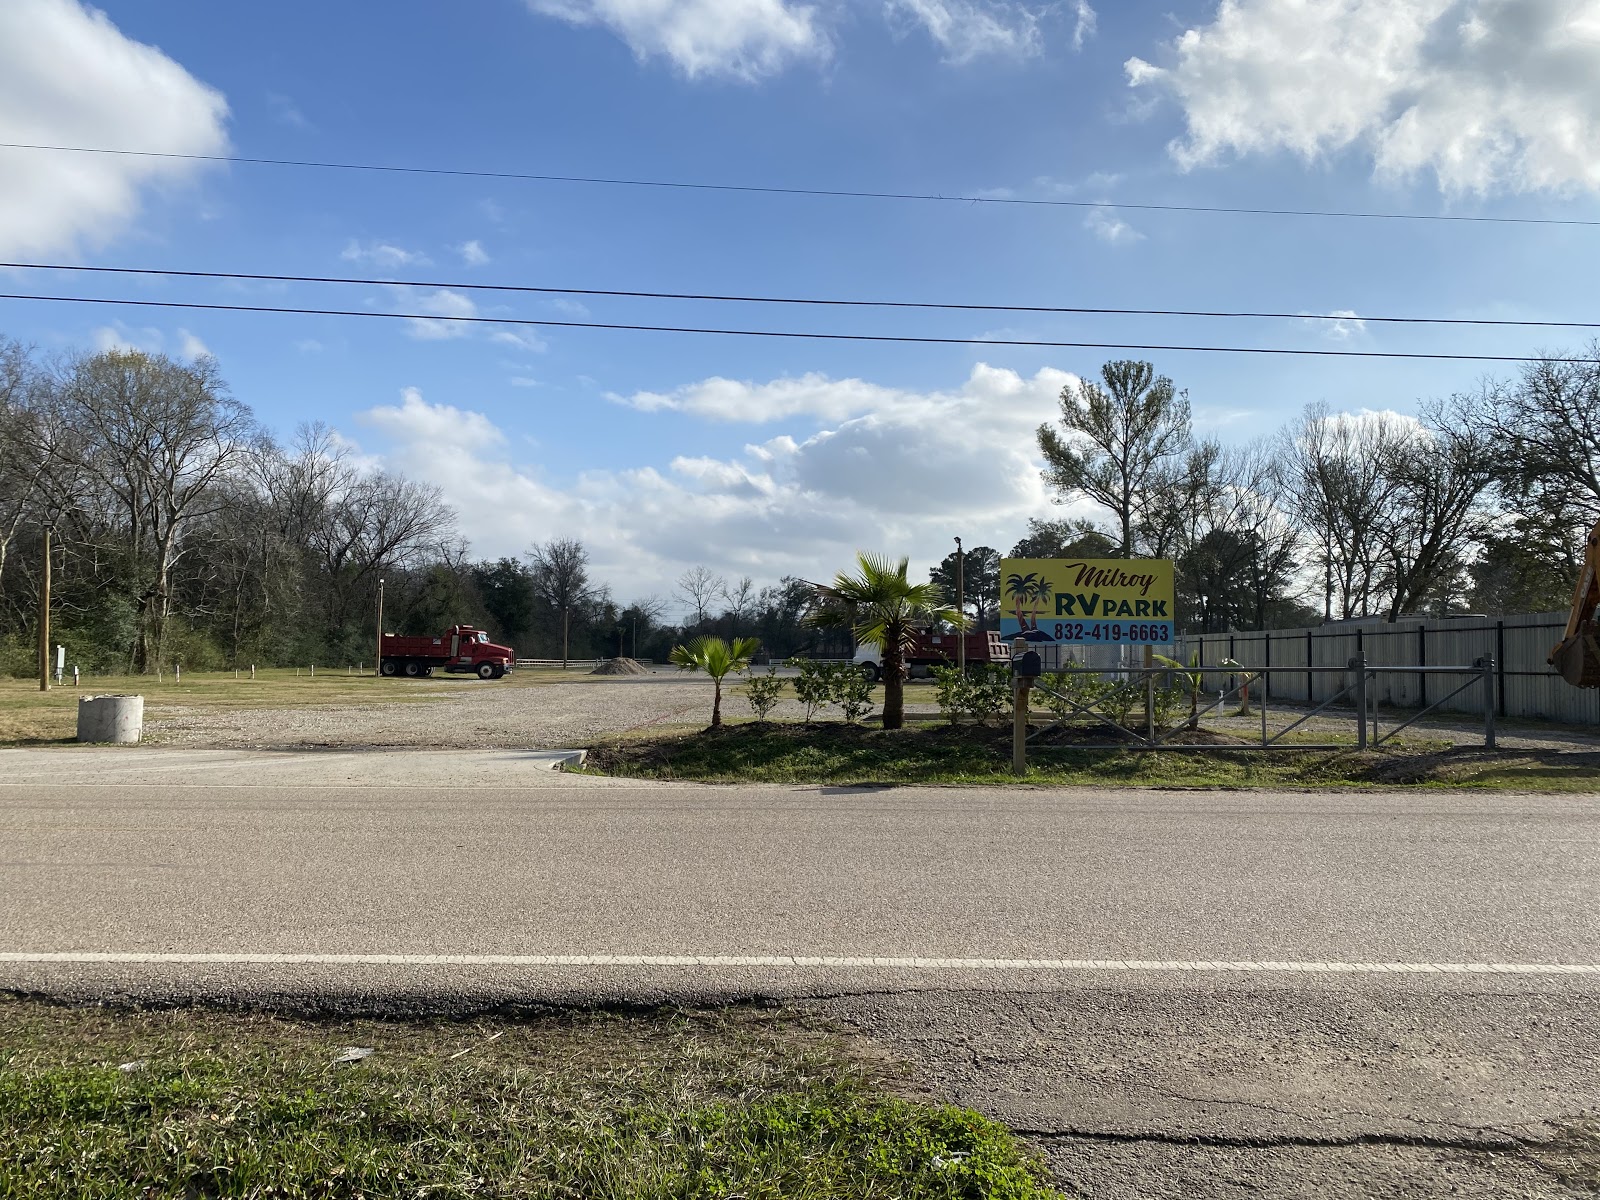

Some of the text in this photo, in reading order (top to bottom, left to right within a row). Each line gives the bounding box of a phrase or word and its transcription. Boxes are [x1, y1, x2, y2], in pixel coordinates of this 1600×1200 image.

[1065, 562, 1158, 596] Milroy
[1054, 592, 1168, 617] RV PARK
[1054, 623, 1169, 641] 832-419-6663
